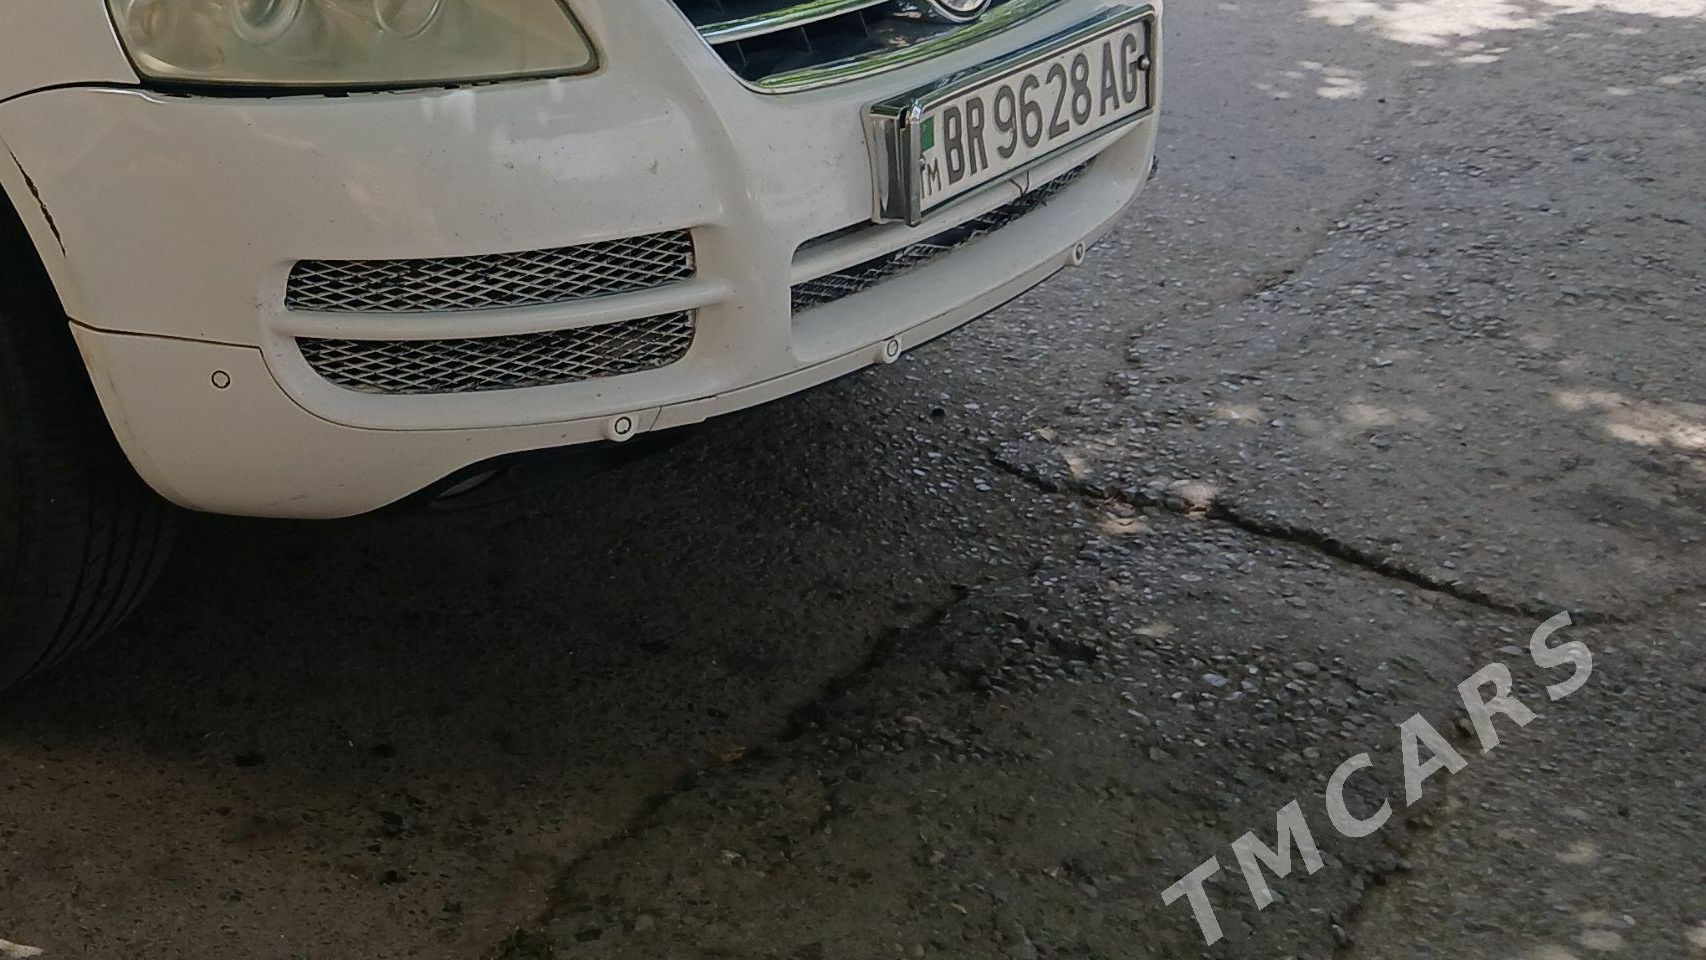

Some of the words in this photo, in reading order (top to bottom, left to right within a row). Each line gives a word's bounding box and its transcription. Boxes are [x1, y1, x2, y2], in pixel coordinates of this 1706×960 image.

[944, 96, 989, 186] BR
[994, 52, 1093, 160] 9628
[1099, 32, 1138, 117] AG
